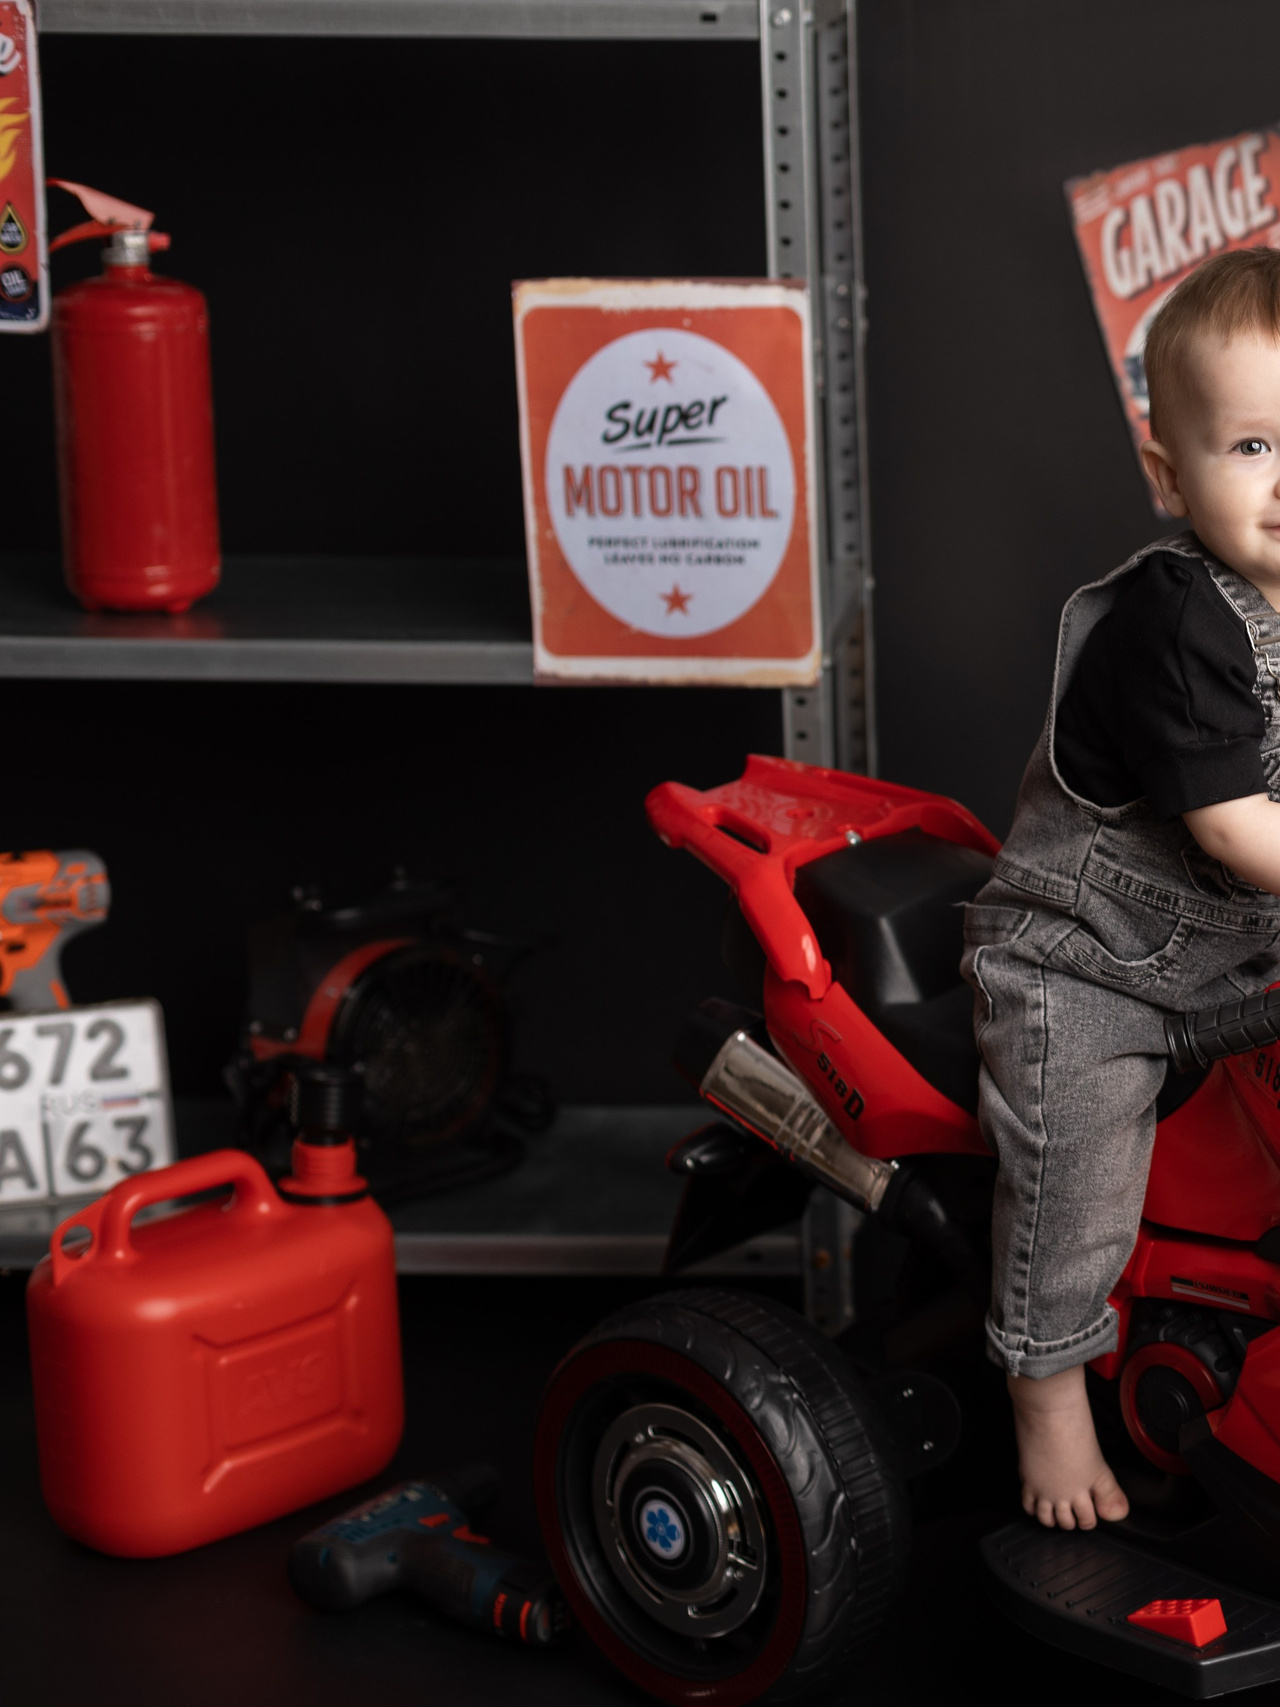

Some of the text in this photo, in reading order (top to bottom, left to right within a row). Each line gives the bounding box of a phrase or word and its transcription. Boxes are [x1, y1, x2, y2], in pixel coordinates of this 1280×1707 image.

[1101, 134, 1277, 300] GARAGE
[602, 393, 729, 447] Super
[562, 463, 779, 519] MOTOR OIL
[587, 536, 648, 549] PERFECT
[603, 553, 745, 567] LEAVES NO CARBON
[0, 1018, 130, 1091] 672
[66, 1115, 154, 1183] 63
